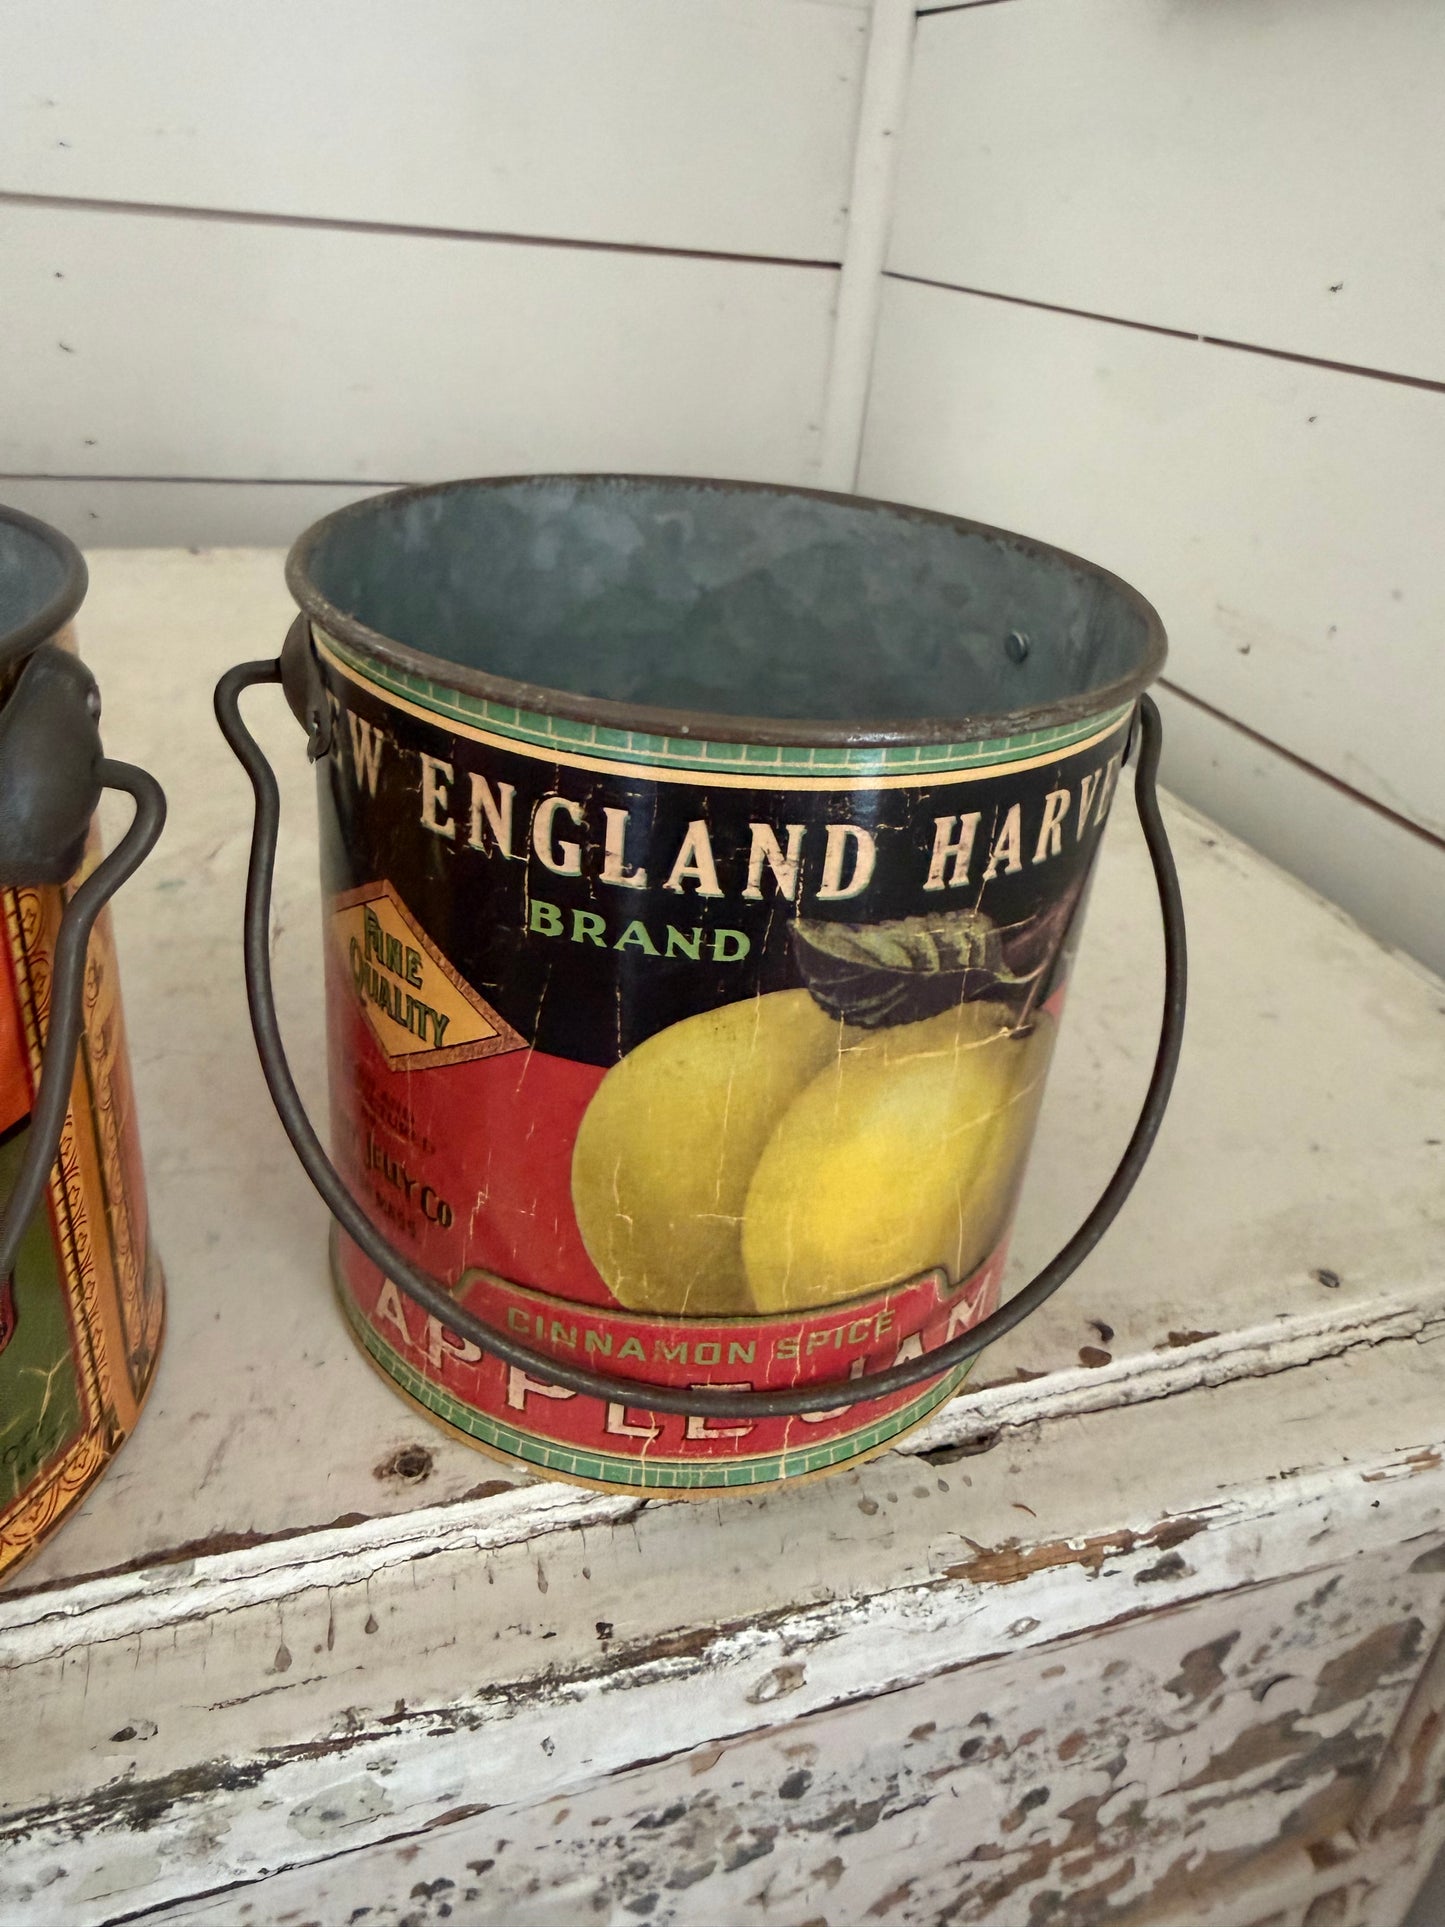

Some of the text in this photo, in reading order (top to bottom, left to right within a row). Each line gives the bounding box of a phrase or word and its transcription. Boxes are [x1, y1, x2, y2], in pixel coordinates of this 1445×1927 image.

[419, 751, 877, 900] ENGLAND
[364, 903, 424, 980] FINE
[529, 899, 751, 962] BRAND
[349, 936, 450, 1049] QUALITY
[507, 1307, 897, 1365] CINNAMON SPICE
